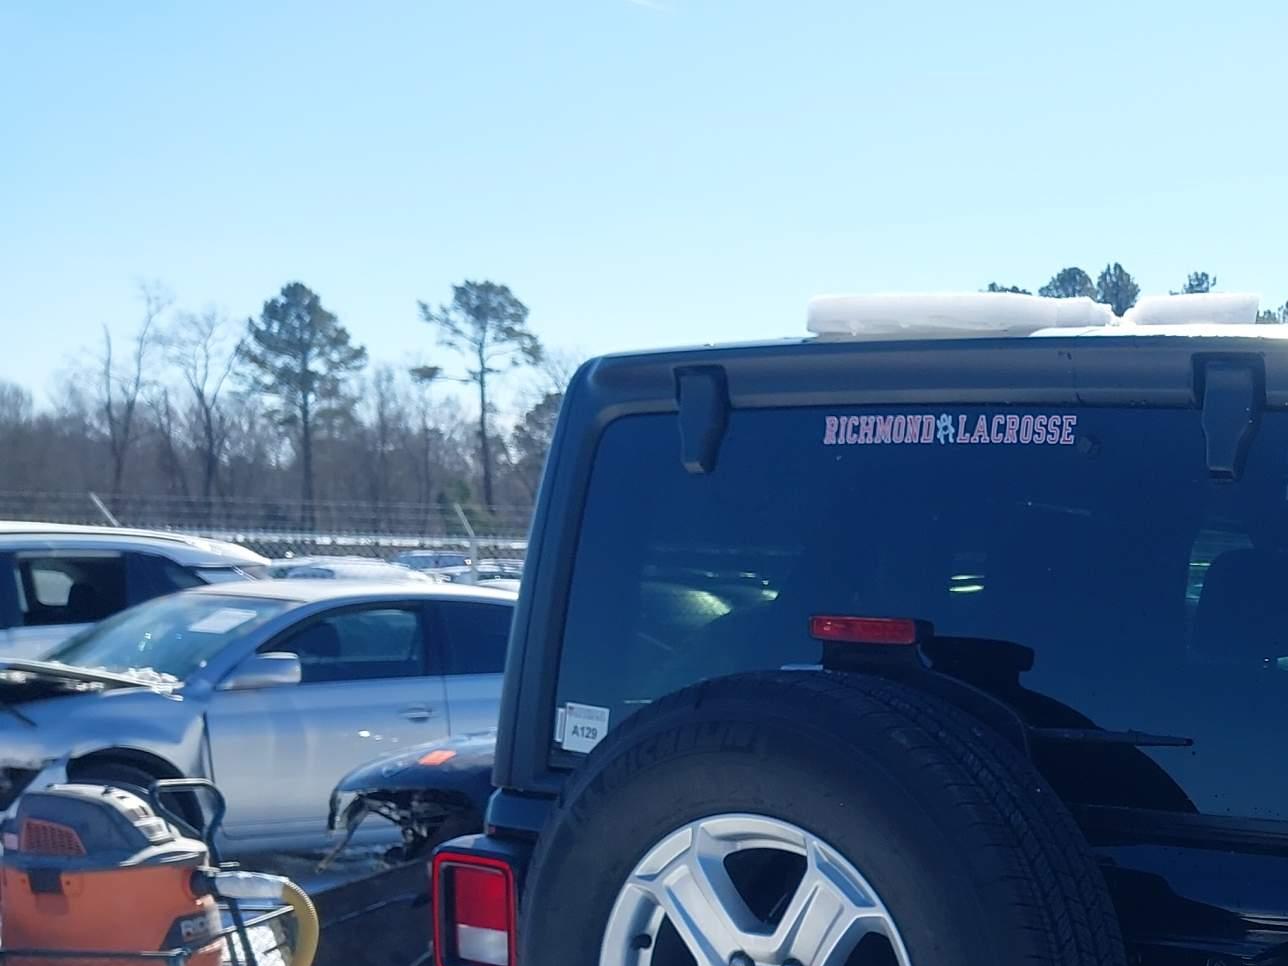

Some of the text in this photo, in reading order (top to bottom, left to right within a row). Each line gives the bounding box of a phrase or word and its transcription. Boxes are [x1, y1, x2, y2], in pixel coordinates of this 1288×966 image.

[823, 414, 1077, 445] RICHMOND LACROSSE
[571, 725, 598, 740] A129
